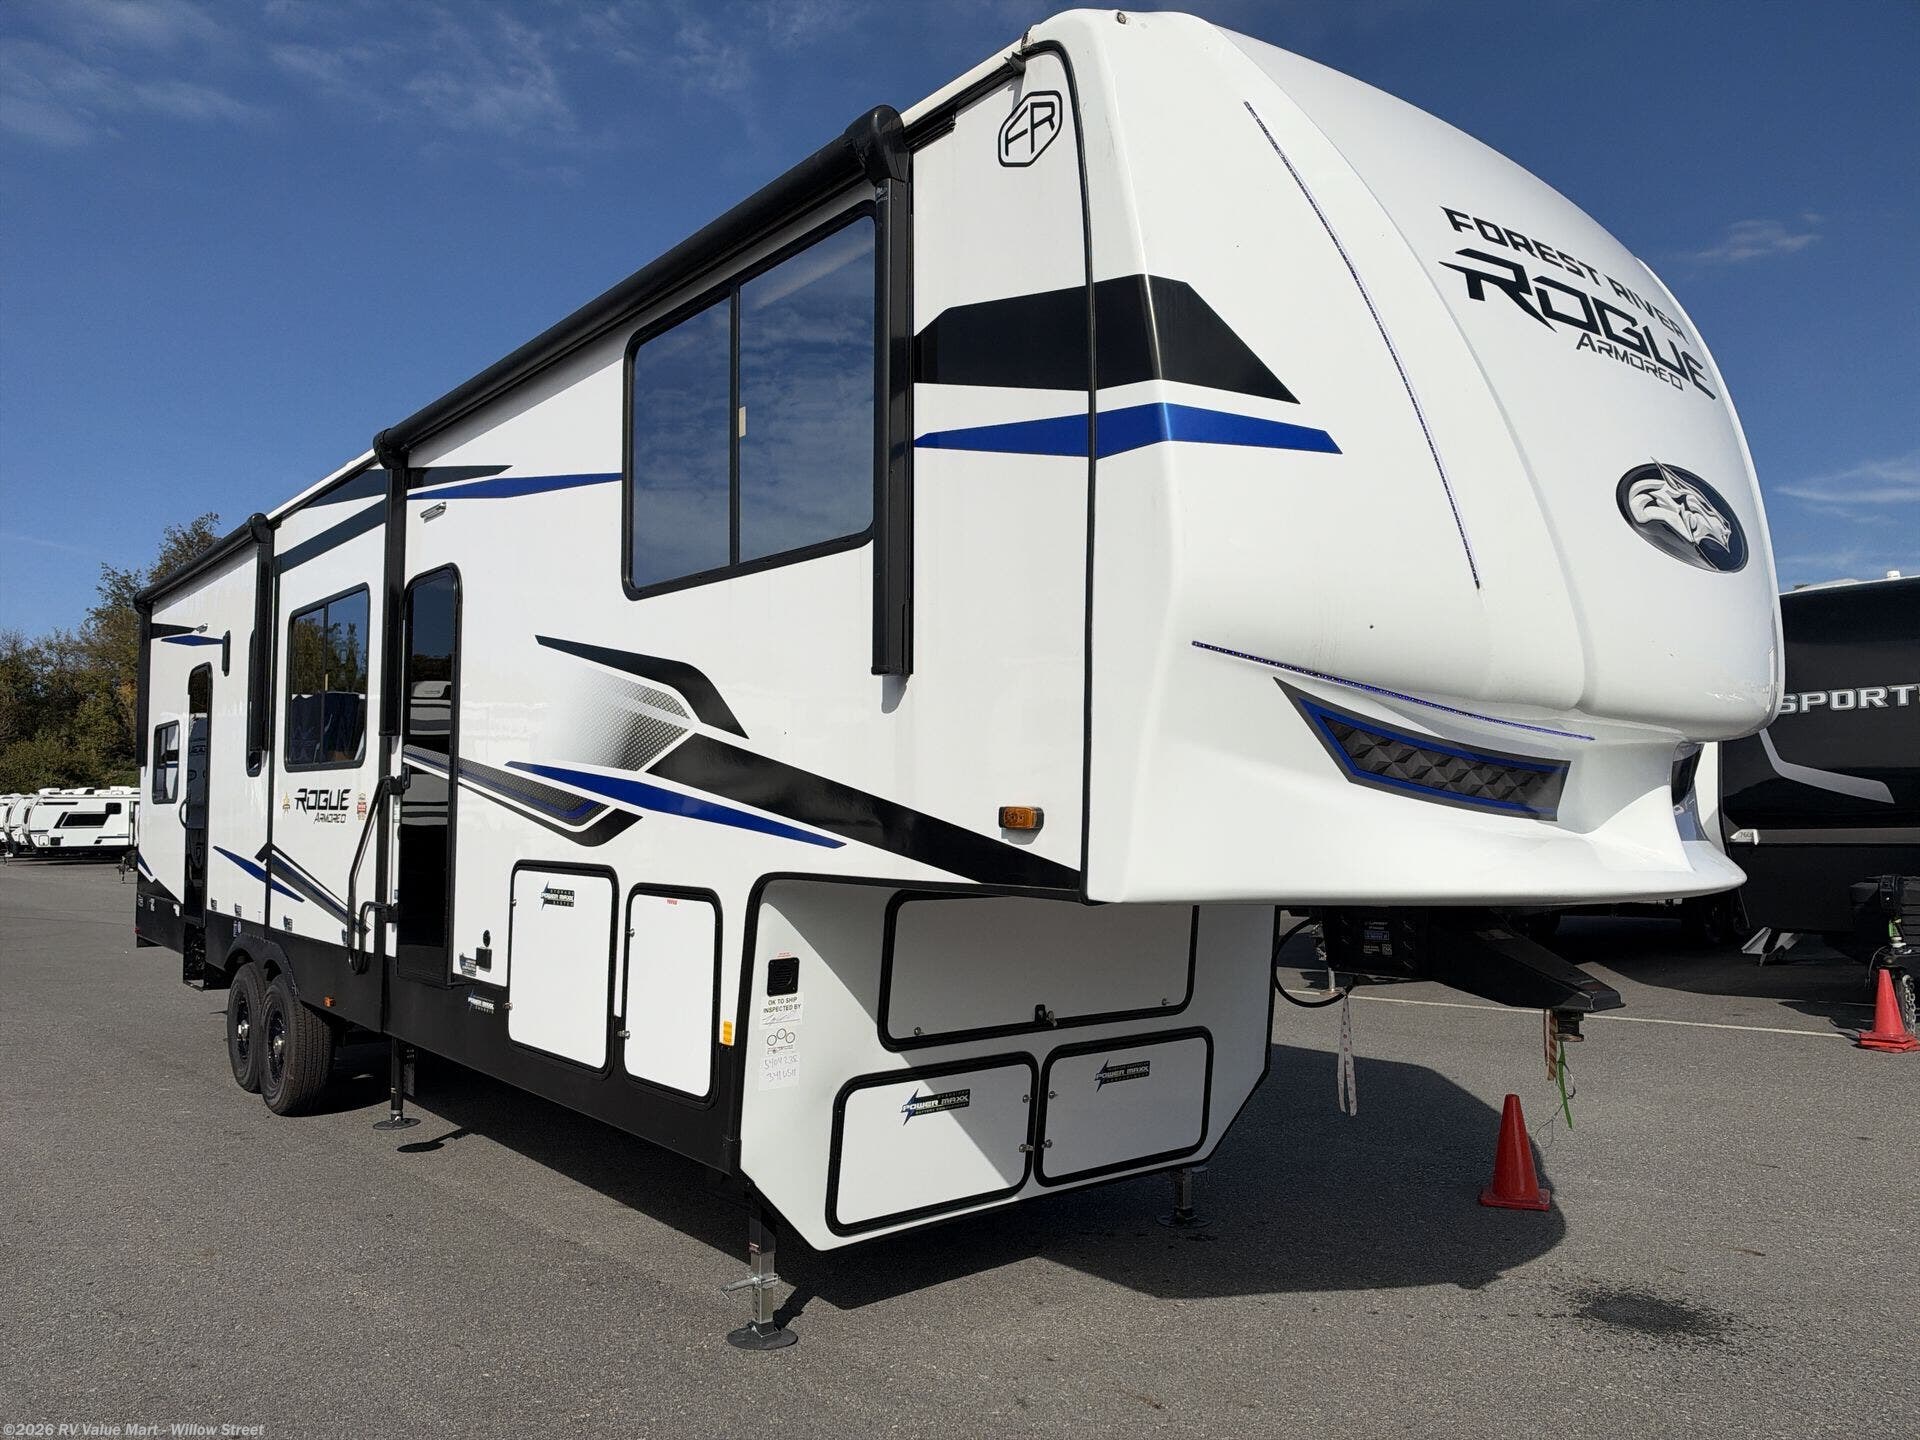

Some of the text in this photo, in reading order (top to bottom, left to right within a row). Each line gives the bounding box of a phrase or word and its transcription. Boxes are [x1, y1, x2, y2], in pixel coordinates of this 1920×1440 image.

[1440, 205, 1690, 346] FOREST RIVER
[1438, 247, 1716, 401] ROGUE
[1575, 331, 1684, 392] ARMORED
[1779, 683, 1920, 715] SPORT
[294, 788, 352, 815] ROGUE
[313, 812, 347, 825] ARMORED
[763, 1003, 802, 1014] INSPECTED BY
[768, 996, 798, 1006] OK TO SHIP
[1095, 1069, 1125, 1080] POWER
[1126, 1066, 1149, 1075] MAXX
[901, 1095, 969, 1112] POWER MAXX
